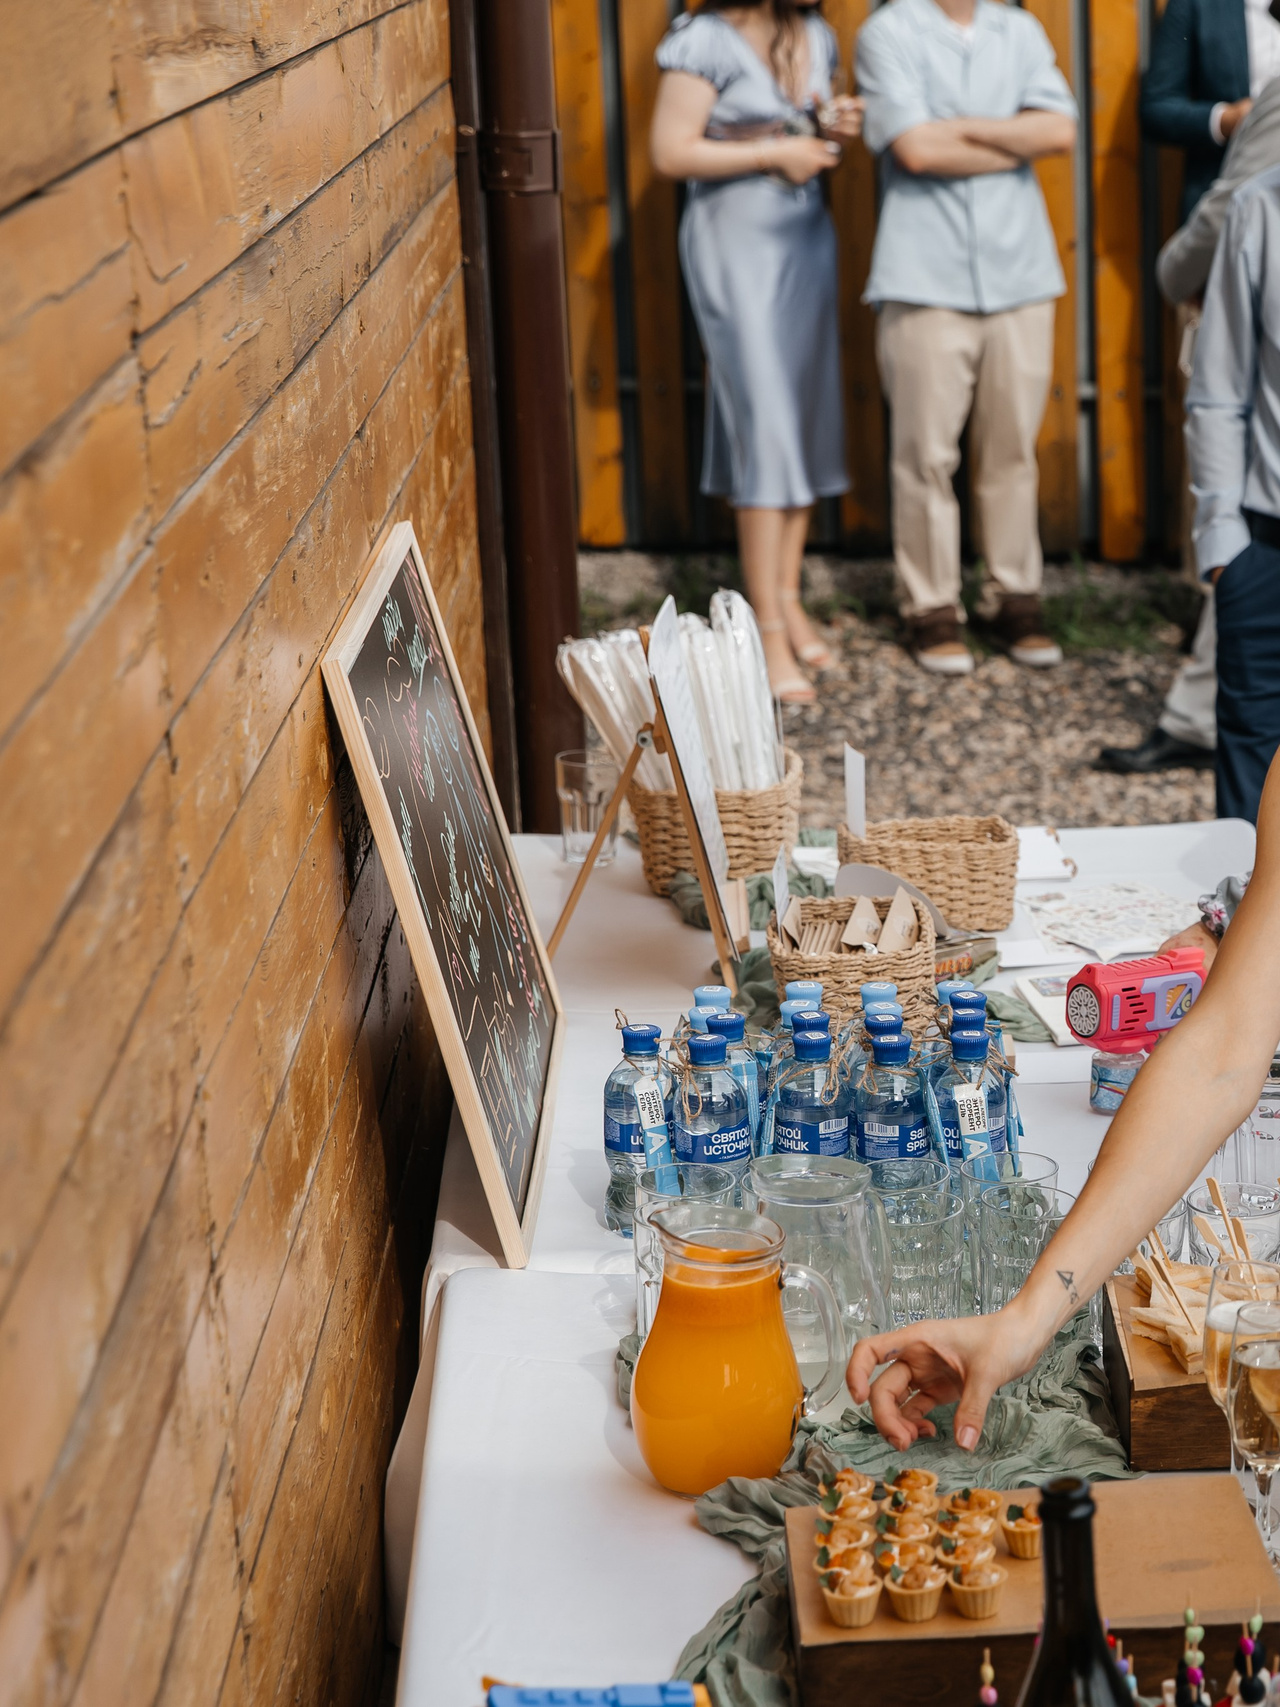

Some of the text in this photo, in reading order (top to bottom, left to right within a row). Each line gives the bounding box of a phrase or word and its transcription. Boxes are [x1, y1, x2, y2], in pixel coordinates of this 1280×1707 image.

[645, 1092, 656, 1124] СОРБЕНТ
[649, 1090, 661, 1122] ЭНТЕРО-
[966, 1098, 975, 1132] СОРБЕНТ
[972, 1098, 981, 1129] ЭНТЕРО-
